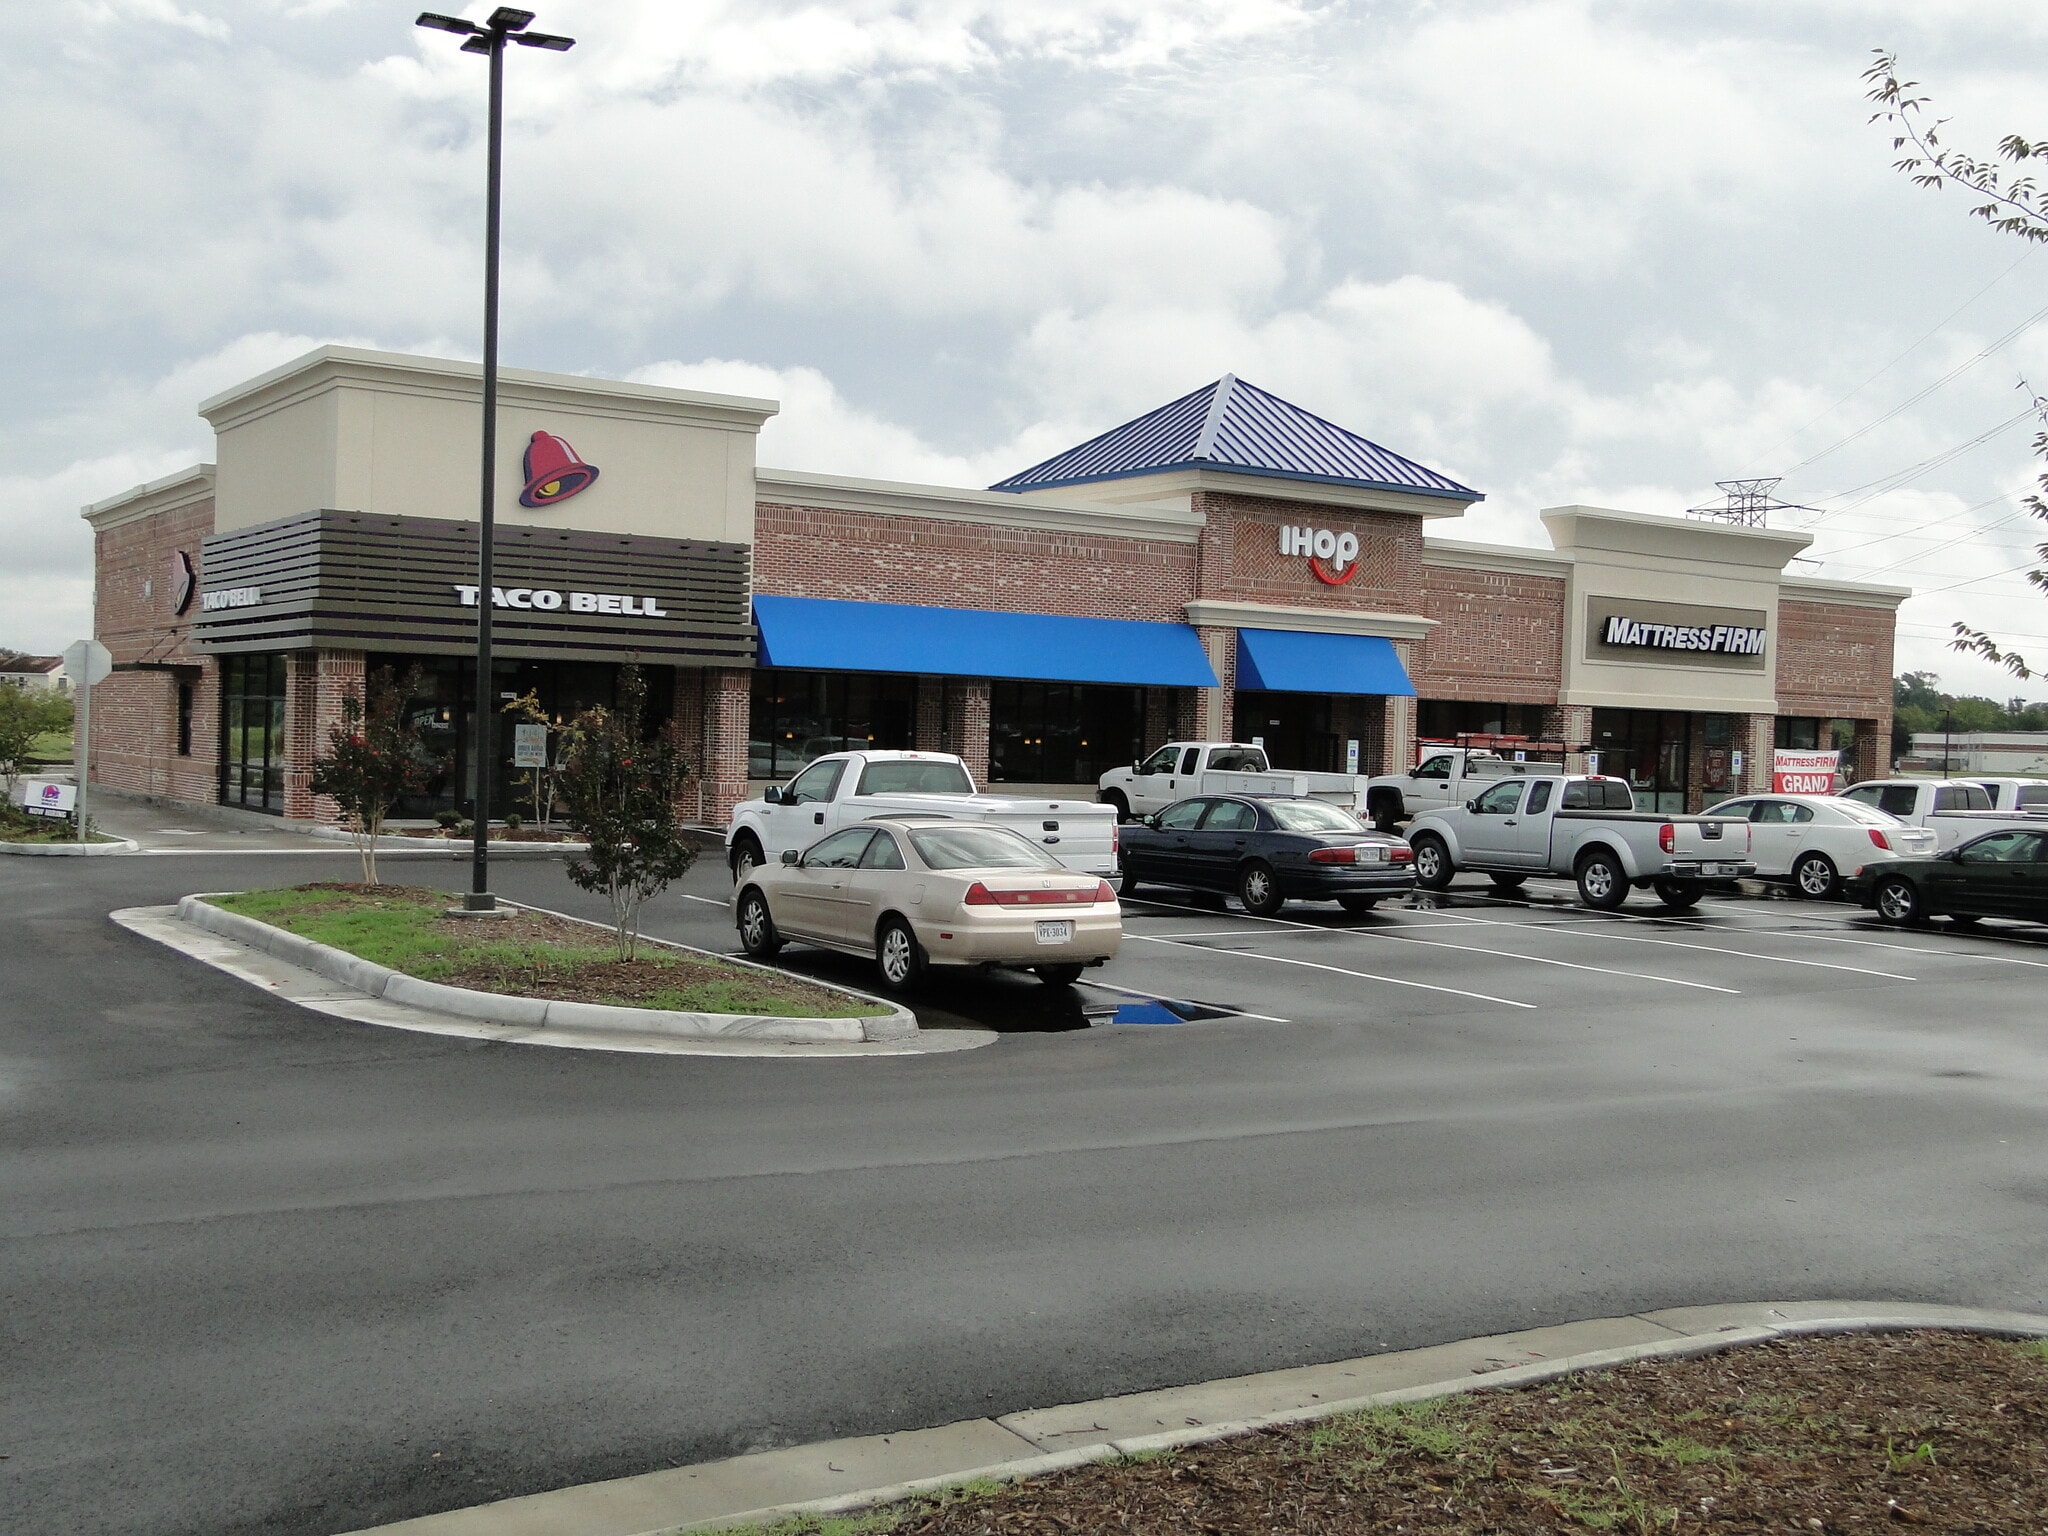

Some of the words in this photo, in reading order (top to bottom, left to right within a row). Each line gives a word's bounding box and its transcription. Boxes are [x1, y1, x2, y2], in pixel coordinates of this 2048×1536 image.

[202, 589, 229, 611] TACO
[229, 586, 263, 606] BELL
[453, 585, 563, 610] TACO
[569, 592, 667, 616] BELL
[1782, 775, 1829, 793] GRAND
